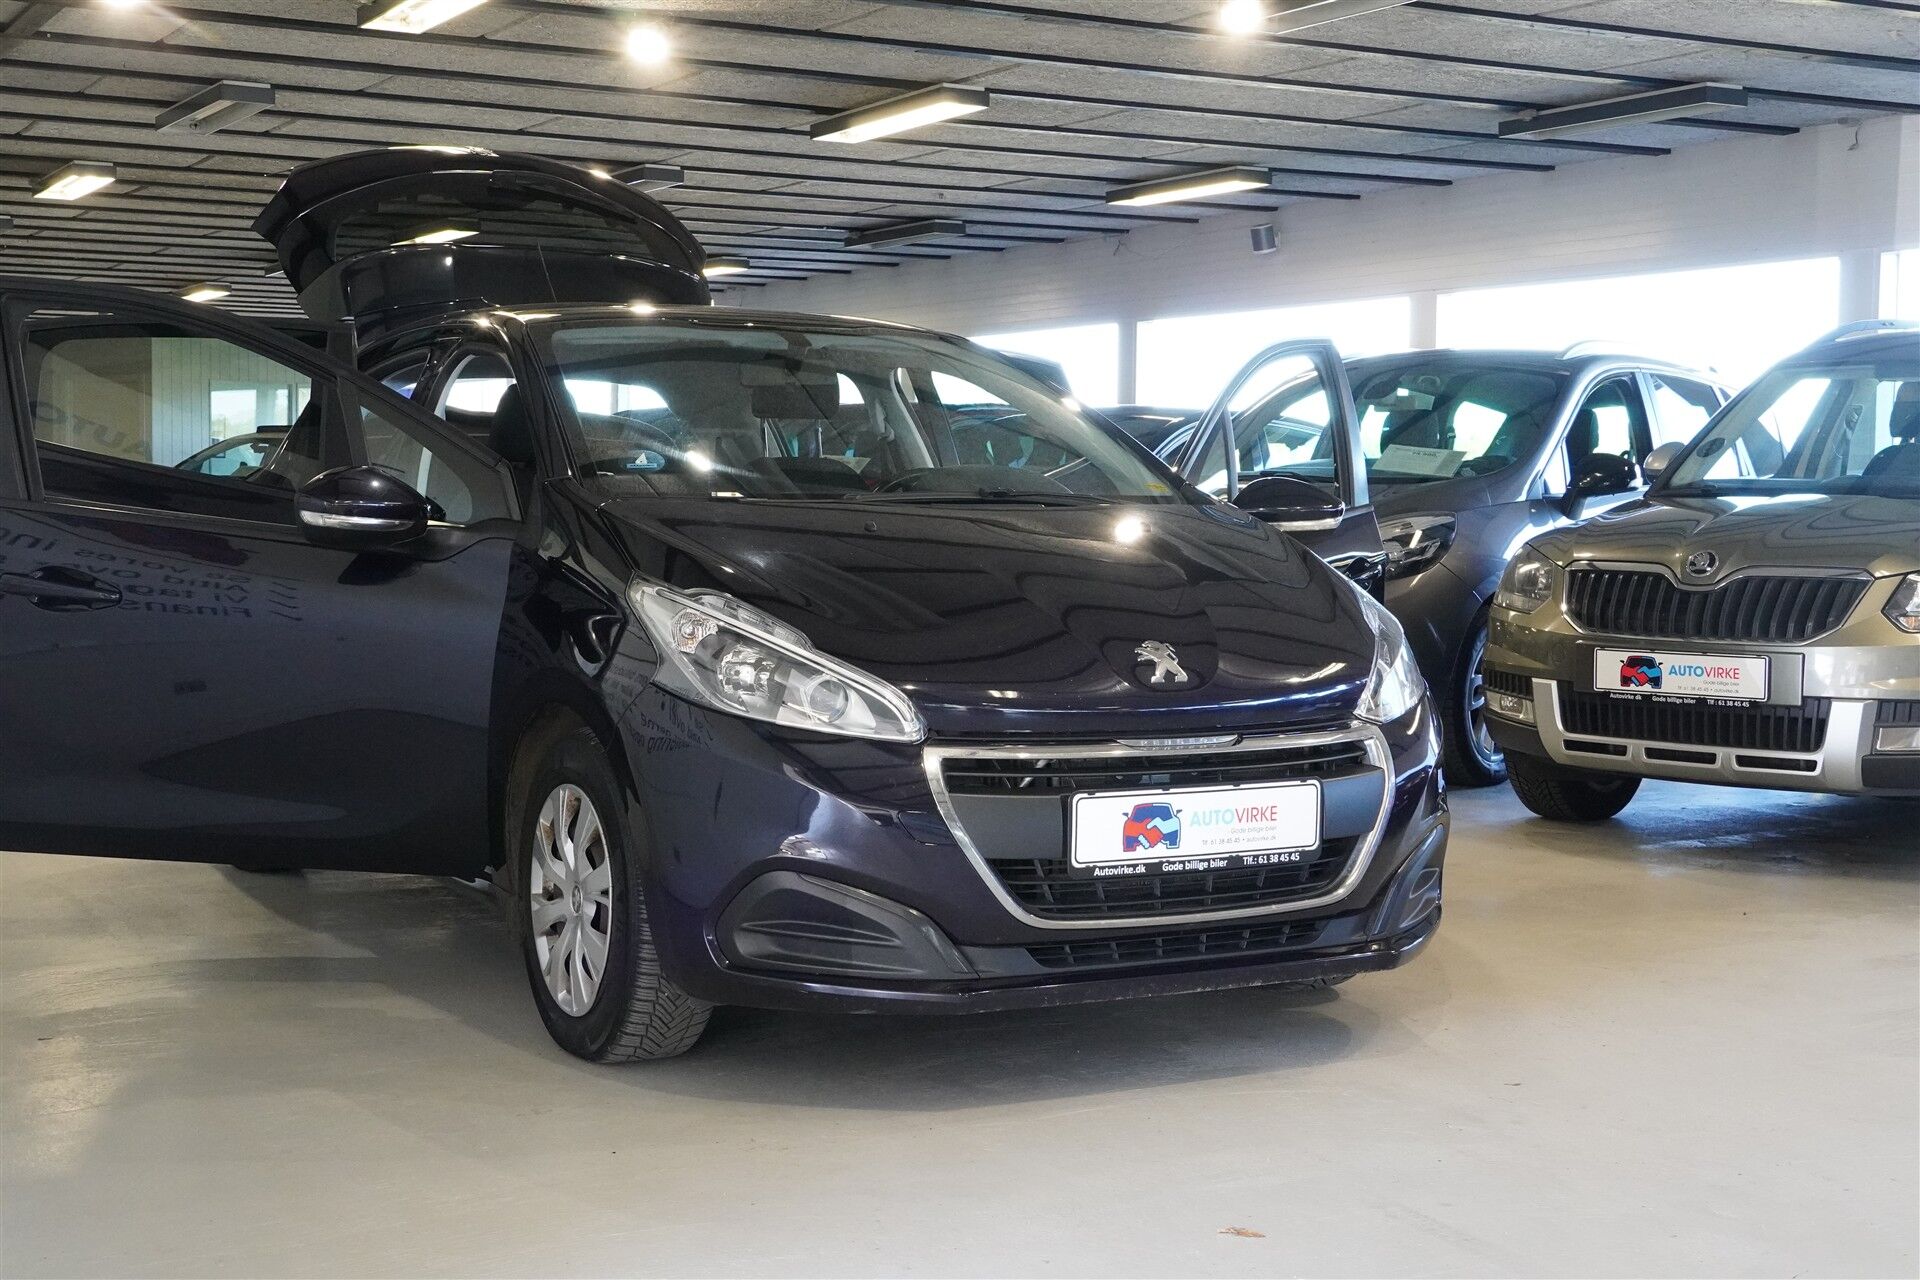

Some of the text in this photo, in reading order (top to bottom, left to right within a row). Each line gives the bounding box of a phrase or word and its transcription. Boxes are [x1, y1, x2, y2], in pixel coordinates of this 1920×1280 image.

[1669, 665, 1740, 680] AUTOVIRKE
[1190, 805, 1278, 827] AUTOVIRKE
[1094, 864, 1146, 876] Autovirke.dk
[1162, 861, 1184, 871] Gode
[1185, 860, 1208, 870] billige
[1210, 859, 1228, 868] biler
[1258, 855, 1268, 864] 61
[1269, 854, 1279, 863] 38
[1280, 853, 1289, 862] 45
[1290, 852, 1300, 861] 45
